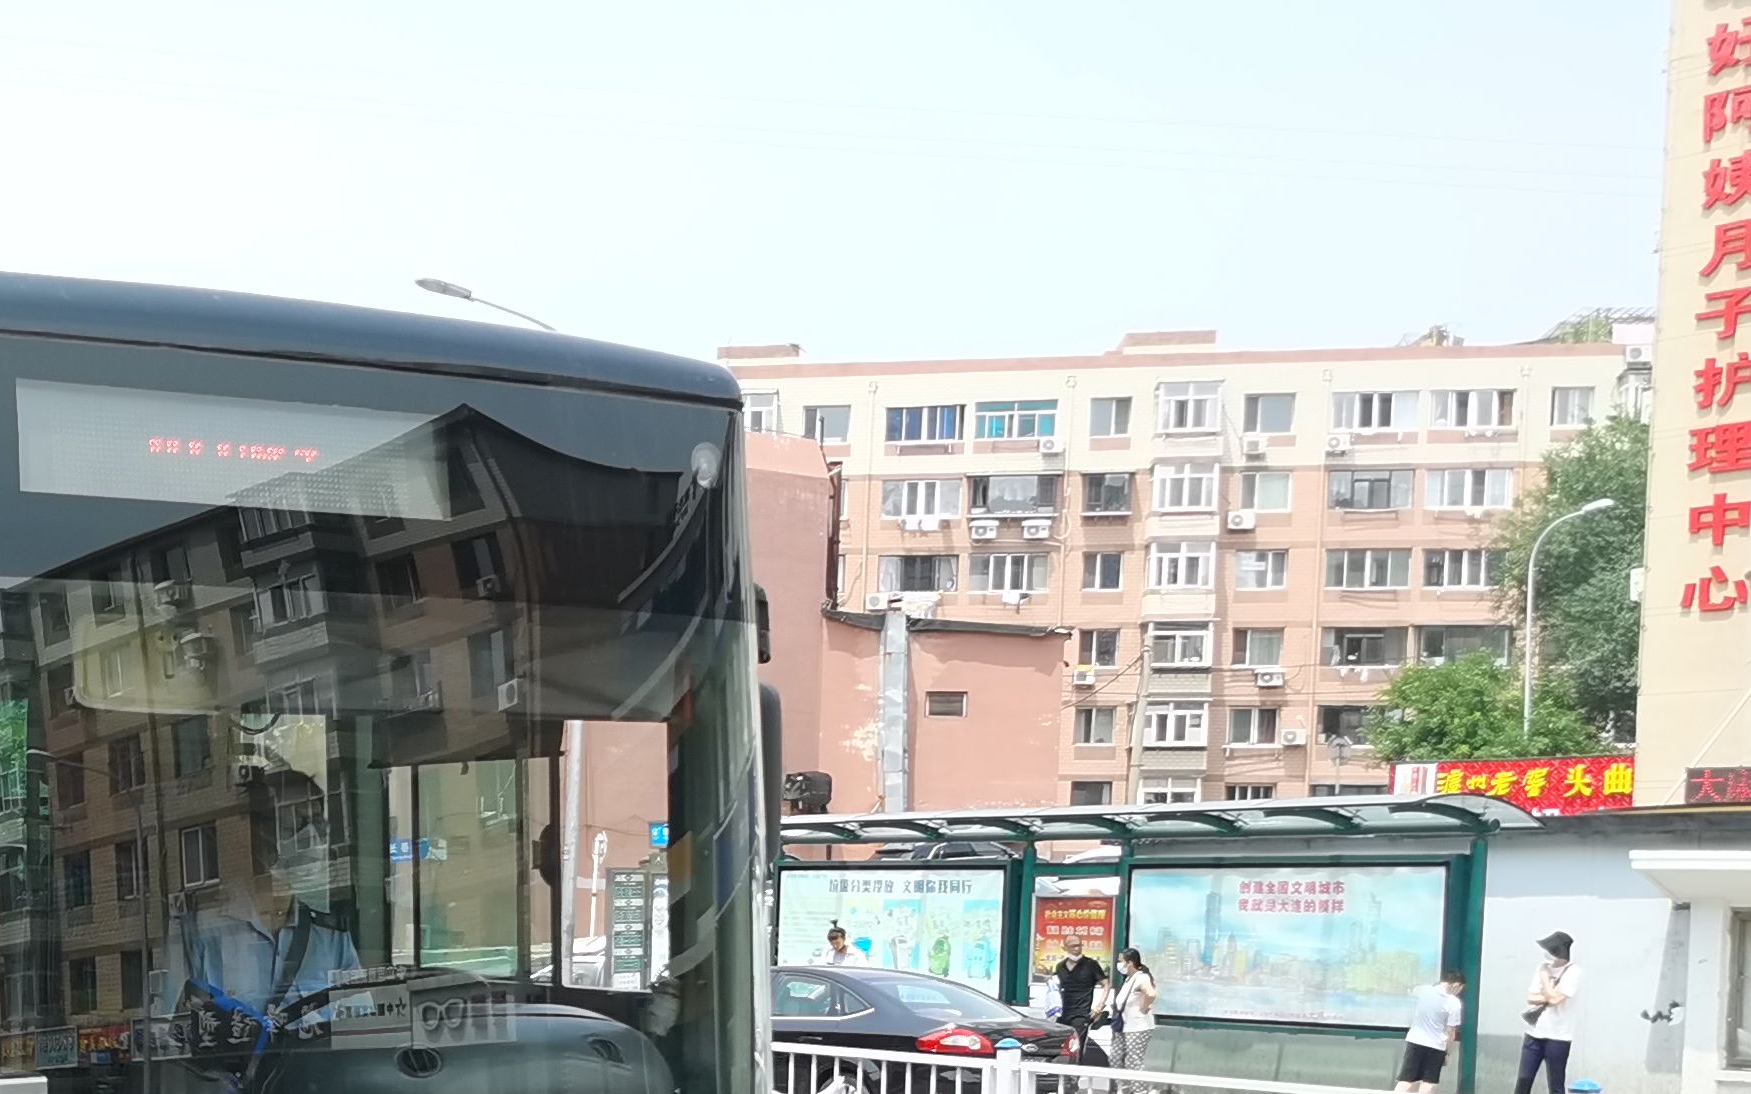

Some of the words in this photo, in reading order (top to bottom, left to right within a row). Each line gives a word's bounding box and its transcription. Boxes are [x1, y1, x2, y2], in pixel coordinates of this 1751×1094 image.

[1239, 880, 1346, 895] 创建全国文明城市
